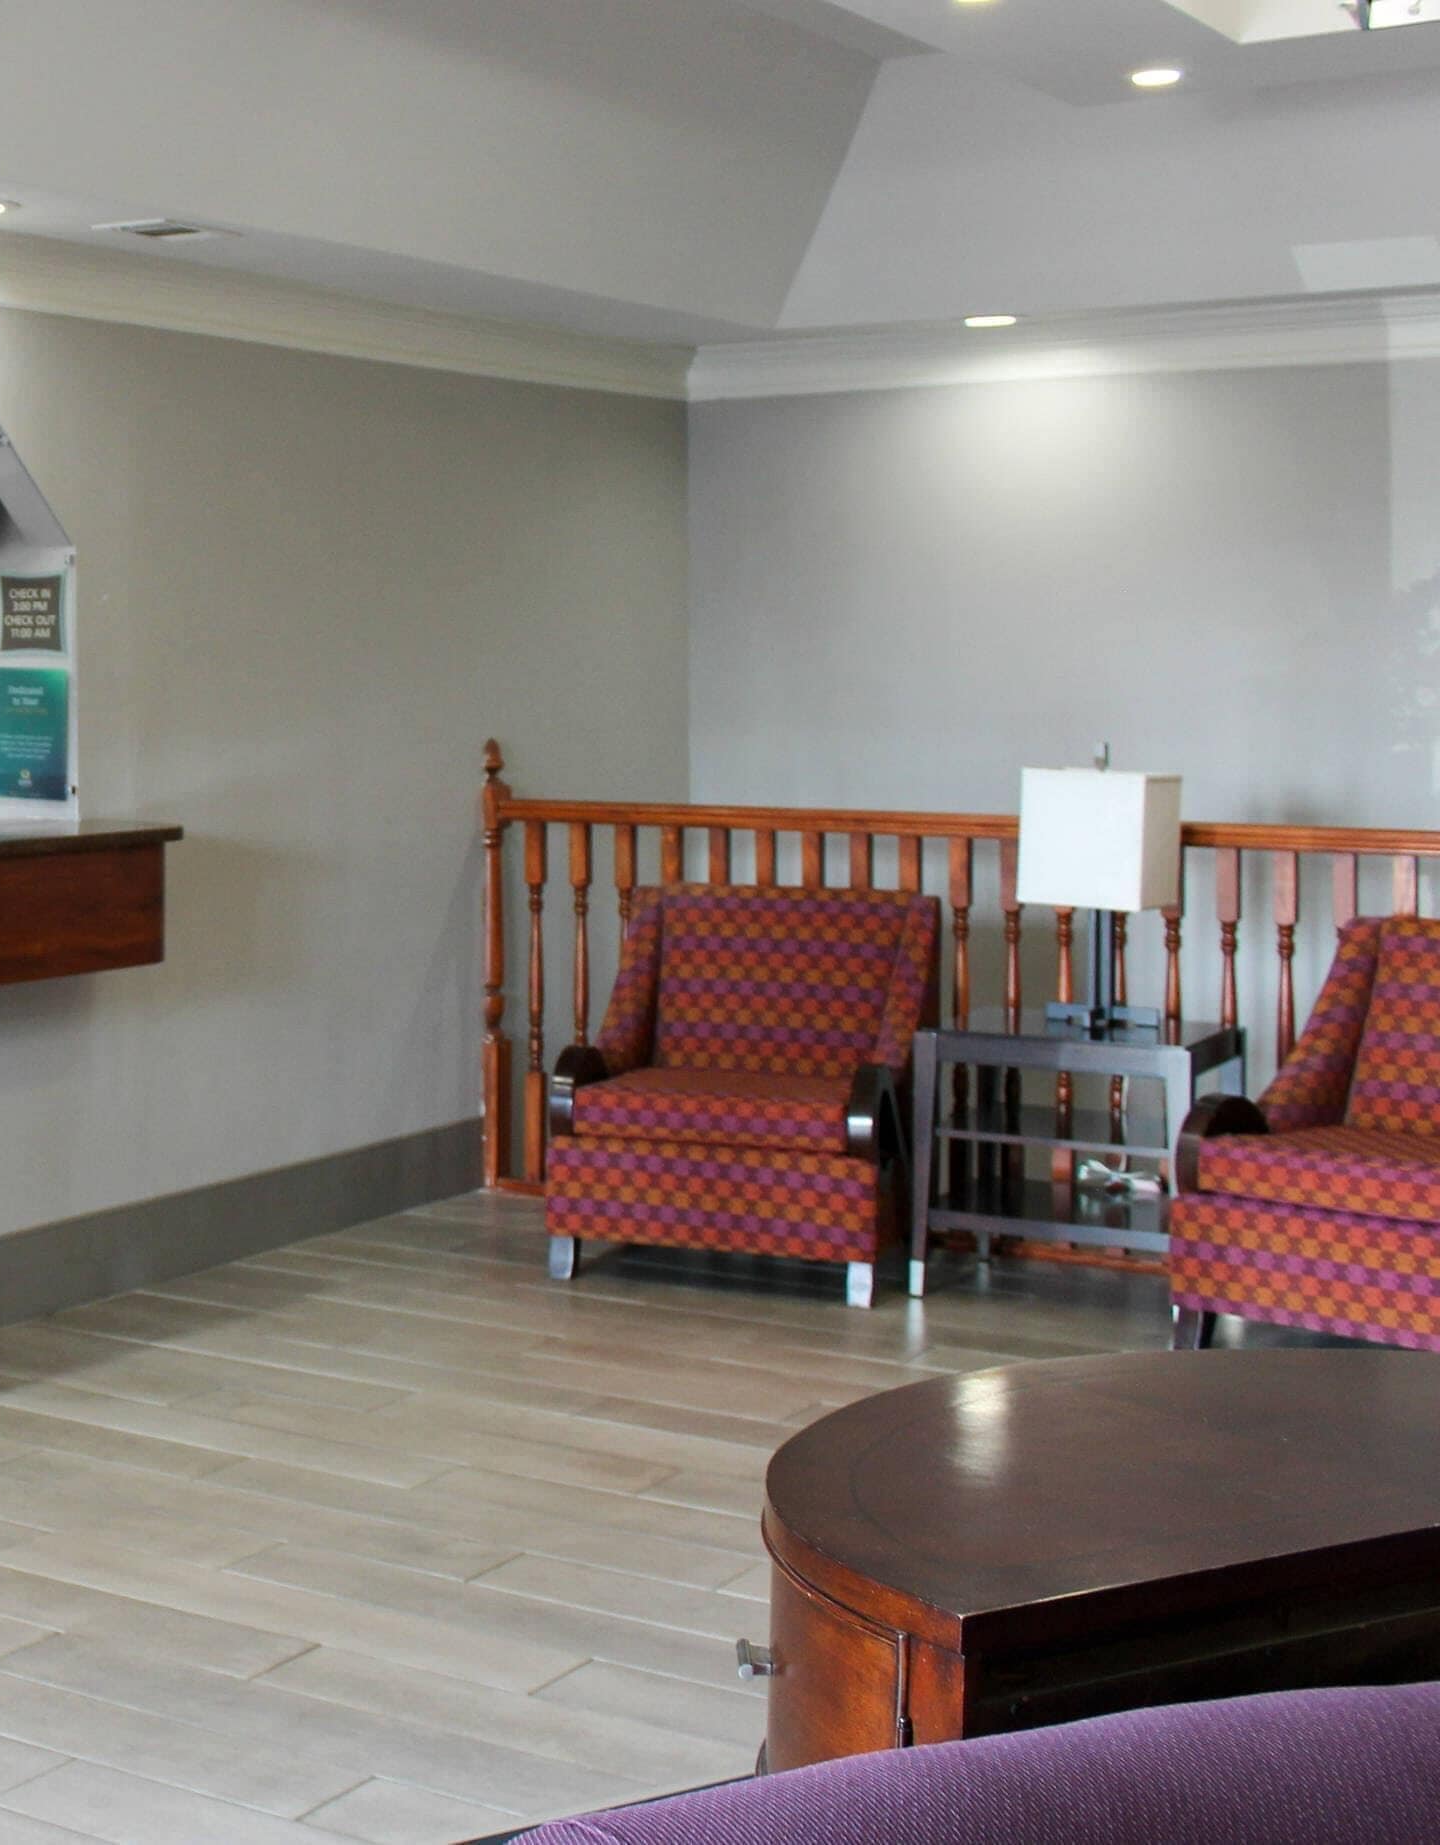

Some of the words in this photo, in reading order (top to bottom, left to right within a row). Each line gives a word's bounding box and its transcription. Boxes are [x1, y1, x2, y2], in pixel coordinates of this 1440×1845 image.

[8, 588, 39, 599] CHECK
[40, 588, 51, 599] IN
[32, 601, 48, 611] PM
[4, 614, 34, 626] CHECK
[35, 614, 56, 625] OUT
[33, 627, 51, 638] AM
